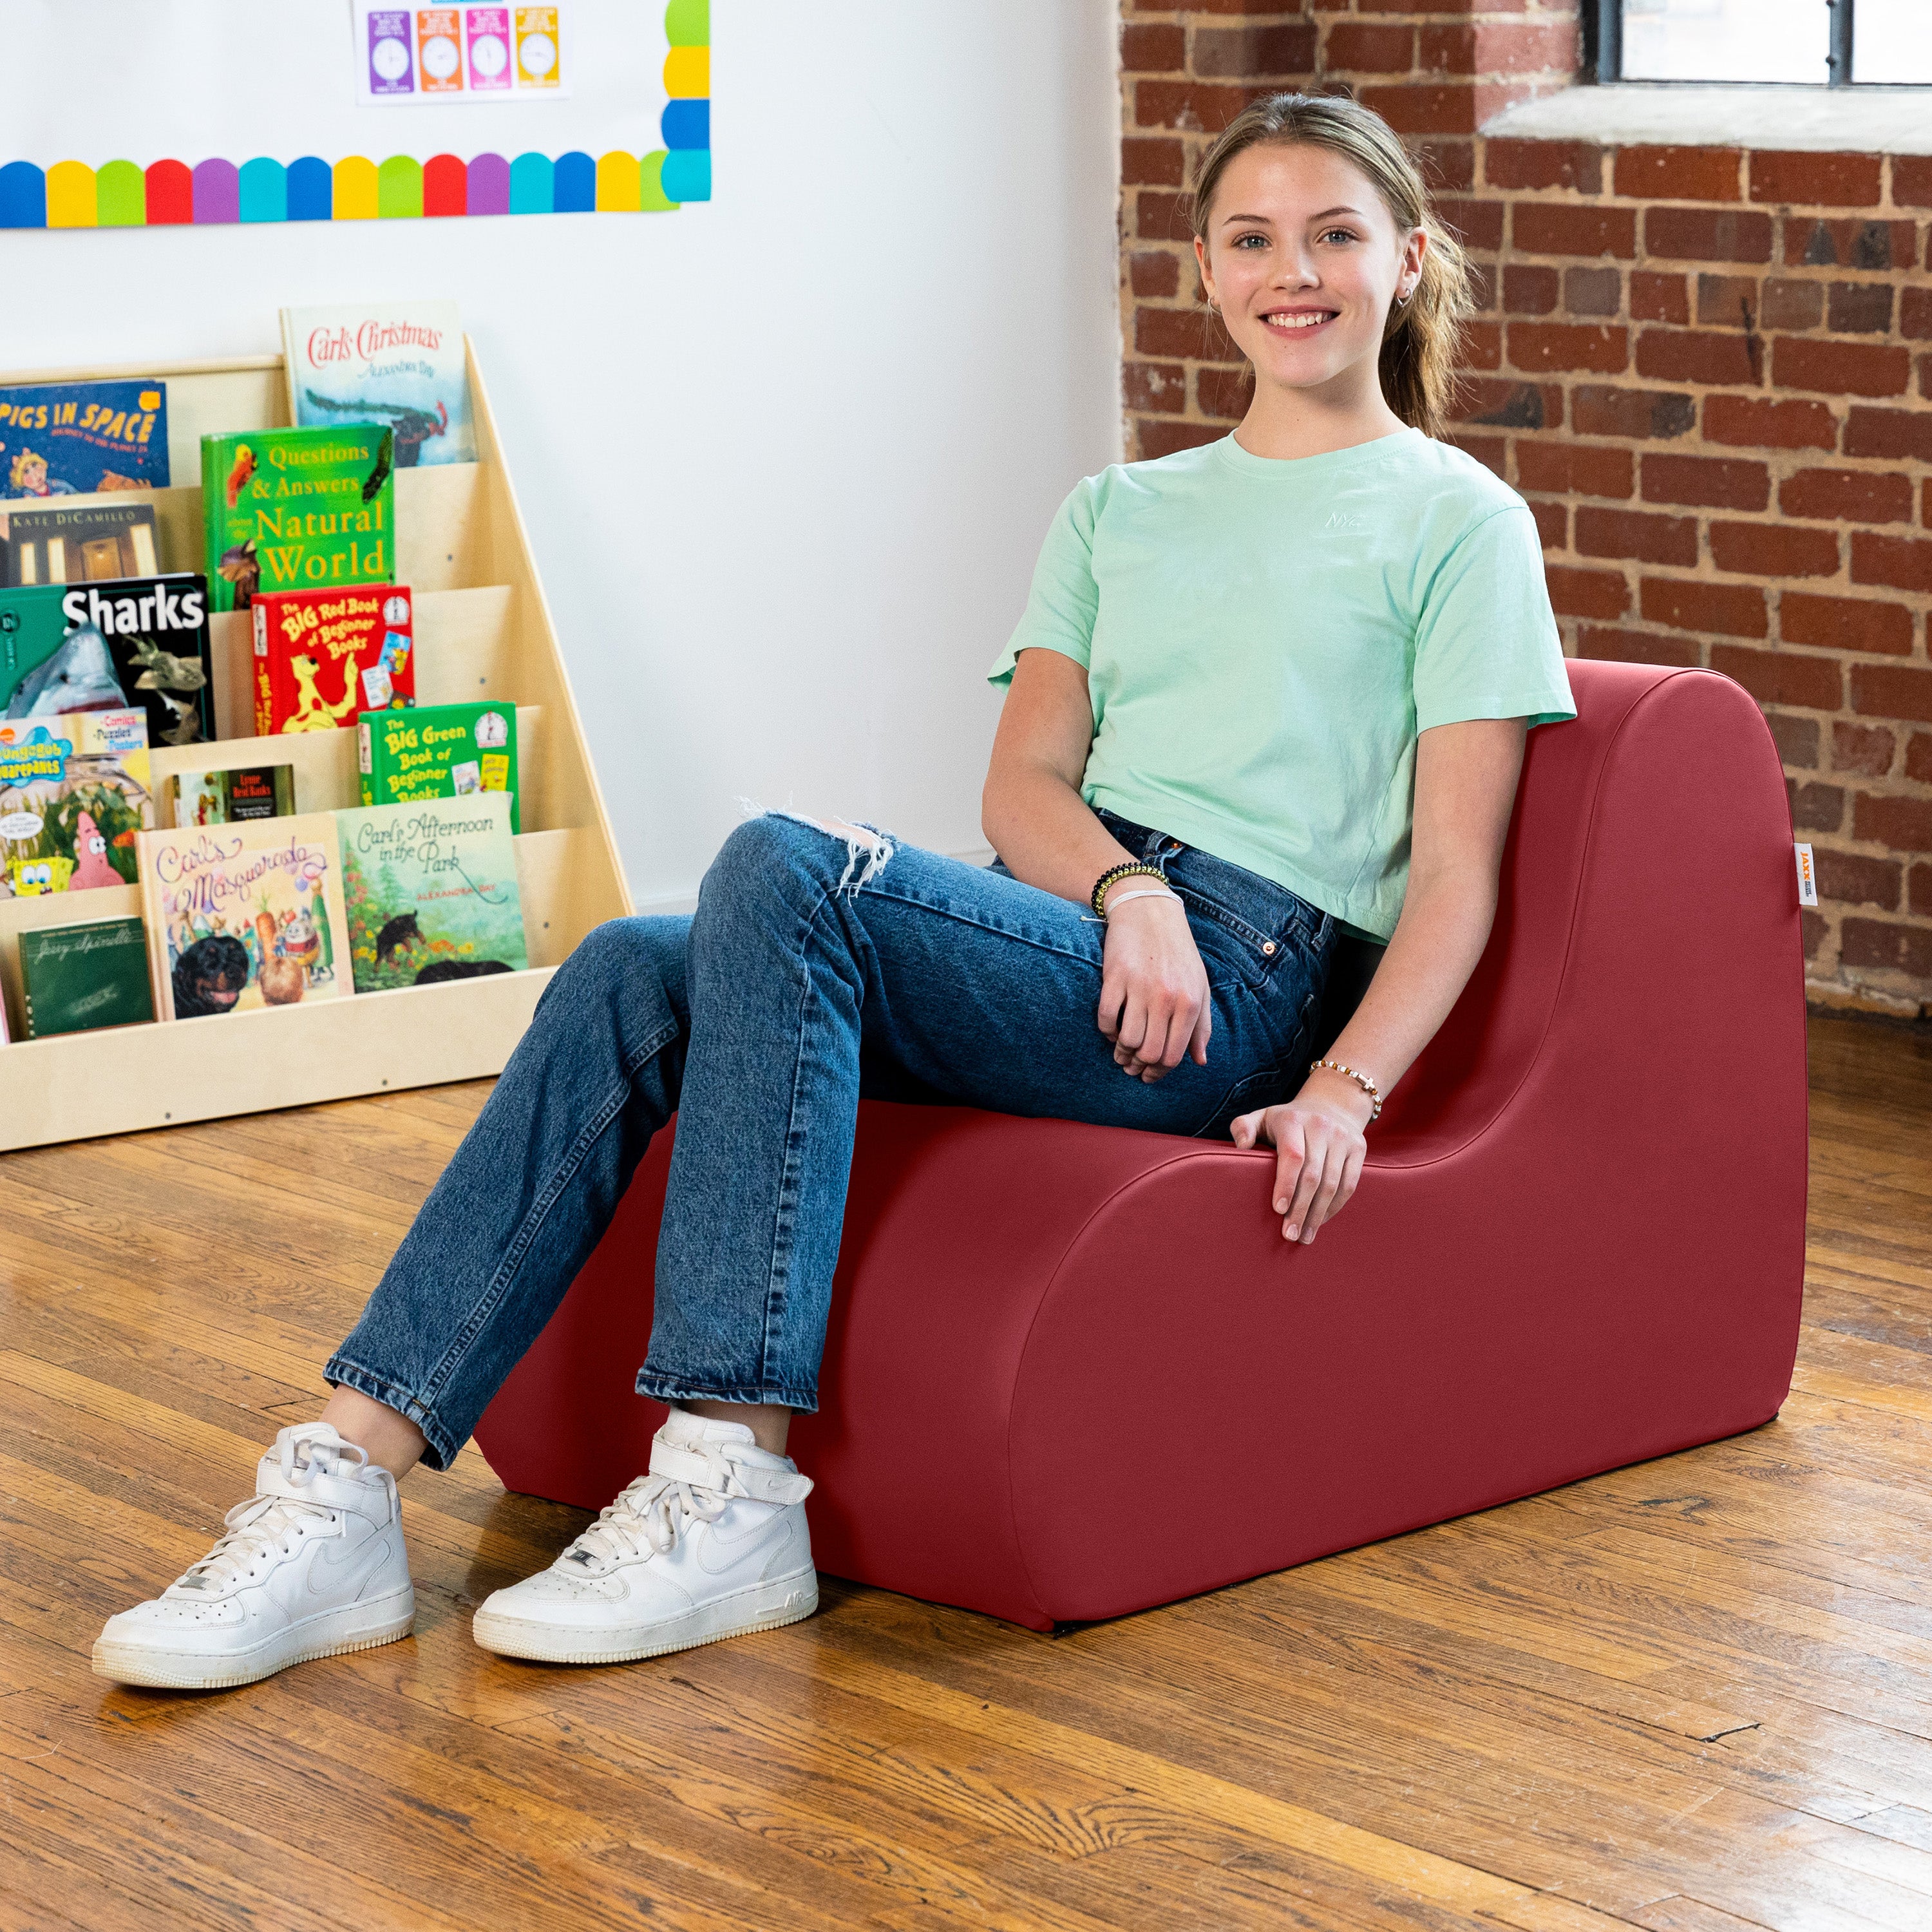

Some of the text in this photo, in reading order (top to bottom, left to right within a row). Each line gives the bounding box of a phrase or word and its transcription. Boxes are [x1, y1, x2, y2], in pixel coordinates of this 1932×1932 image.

[307, 320, 443, 370] Carl's Christmas
[0, 402, 48, 430] PIGS
[53, 402, 78, 426] IN
[79, 403, 156, 443] SPACE
[269, 442, 370, 471] Questions
[252, 477, 359, 499] & Answers
[255, 500, 383, 540] Natural
[1324, 513, 1362, 527] NYC
[264, 540, 384, 582] World
[62, 583, 204, 635] Sharks
[280, 603, 299, 615] The
[280, 605, 319, 643] BIG
[317, 599, 346, 621] Red
[347, 597, 379, 615] Book
[307, 619, 376, 648] of Beginner
[326, 634, 368, 661] Books
[386, 719, 404, 731] The
[384, 728, 418, 755] BIG
[422, 725, 466, 744] Green
[399, 747, 452, 771] Book of
[387, 769, 448, 793] Beginner
[397, 786, 440, 802] Books
[357, 813, 493, 853] Carl's Afternoon
[156, 835, 242, 884] Carl's
[380, 846, 392, 861] in
[395, 841, 415, 863] the
[1801, 852, 1811, 880] JAXX
